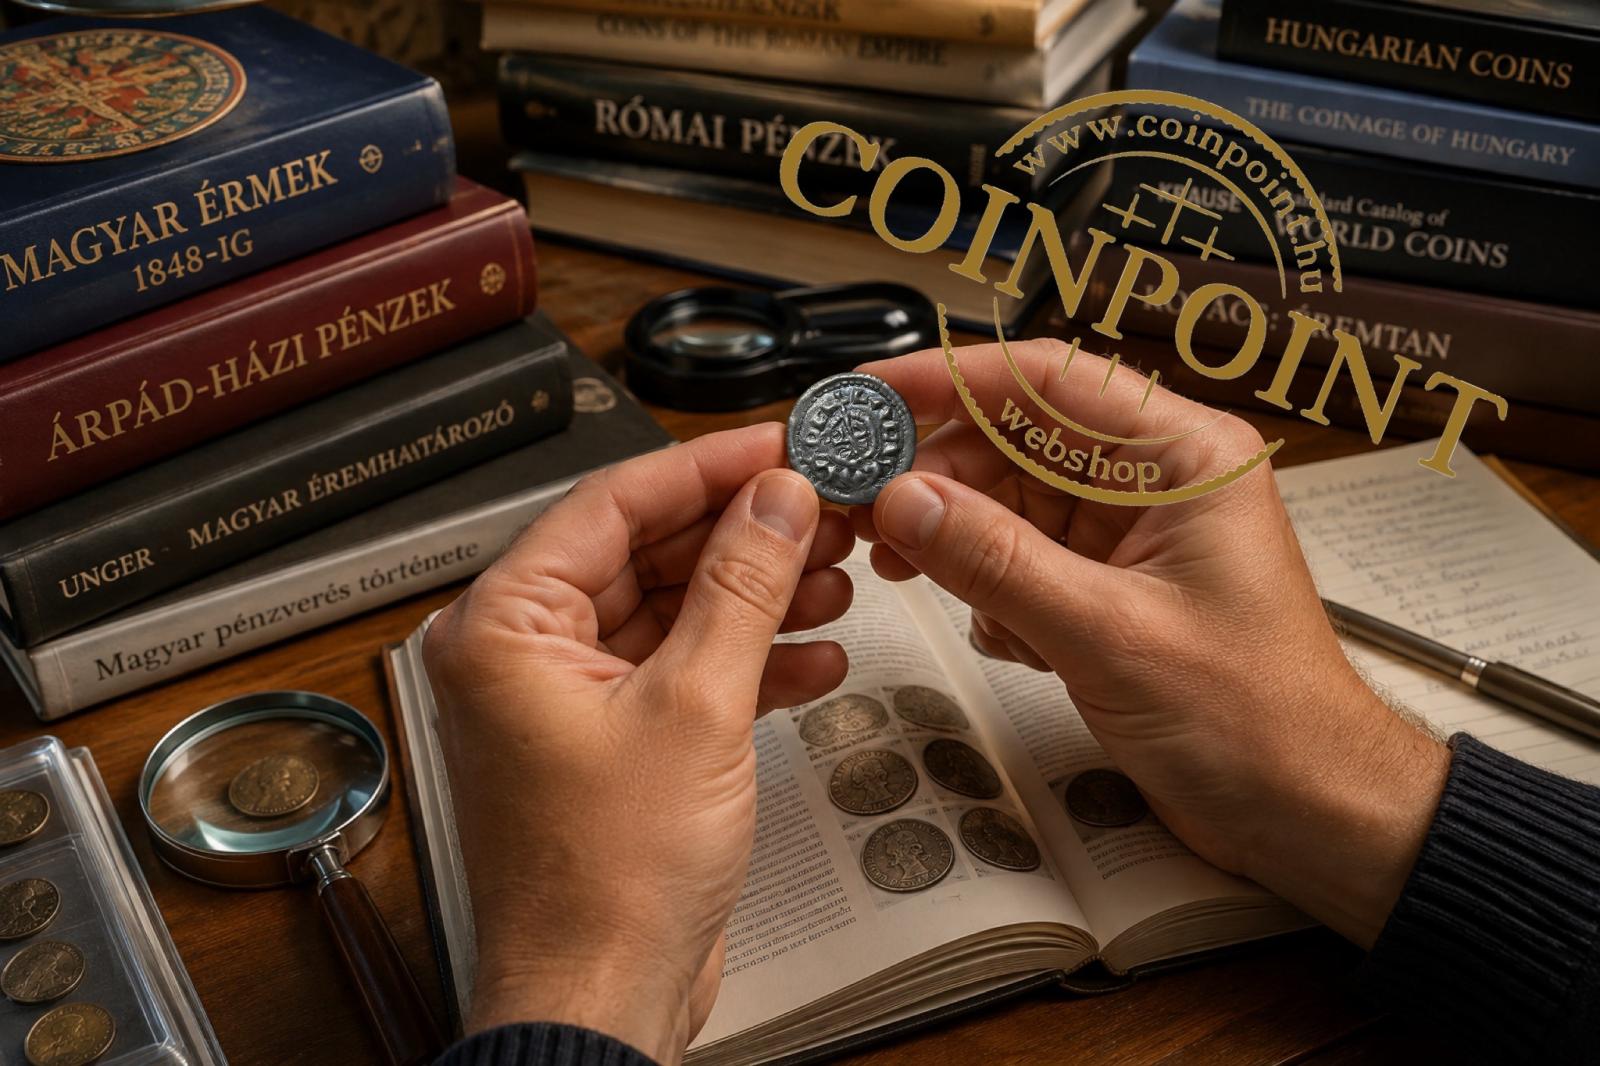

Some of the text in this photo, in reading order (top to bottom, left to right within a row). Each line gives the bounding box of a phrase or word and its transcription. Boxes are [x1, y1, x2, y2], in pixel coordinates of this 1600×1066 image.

[1265, 16, 1573, 89] HUNGARIAN COINS
[595, 94, 725, 148] RÓMAI
[1246, 97, 1575, 166] THE COINAGE OF HUNGARY
[1, 150, 338, 291] MAGYAR ÉRMEK
[1356, 199, 1422, 227] Catalog
[1427, 209, 1449, 226] of
[132, 228, 254, 292] 1848-IG
[1405, 230, 1509, 268] COINS
[47, 278, 456, 462] ÁRPÁD-HÁZI PÉNZEK
[58, 547, 155, 599] UNGER
[187, 489, 303, 549] MAGYAR
[95, 632, 205, 682] Magyar
[215, 582, 351, 647] pénzverés
